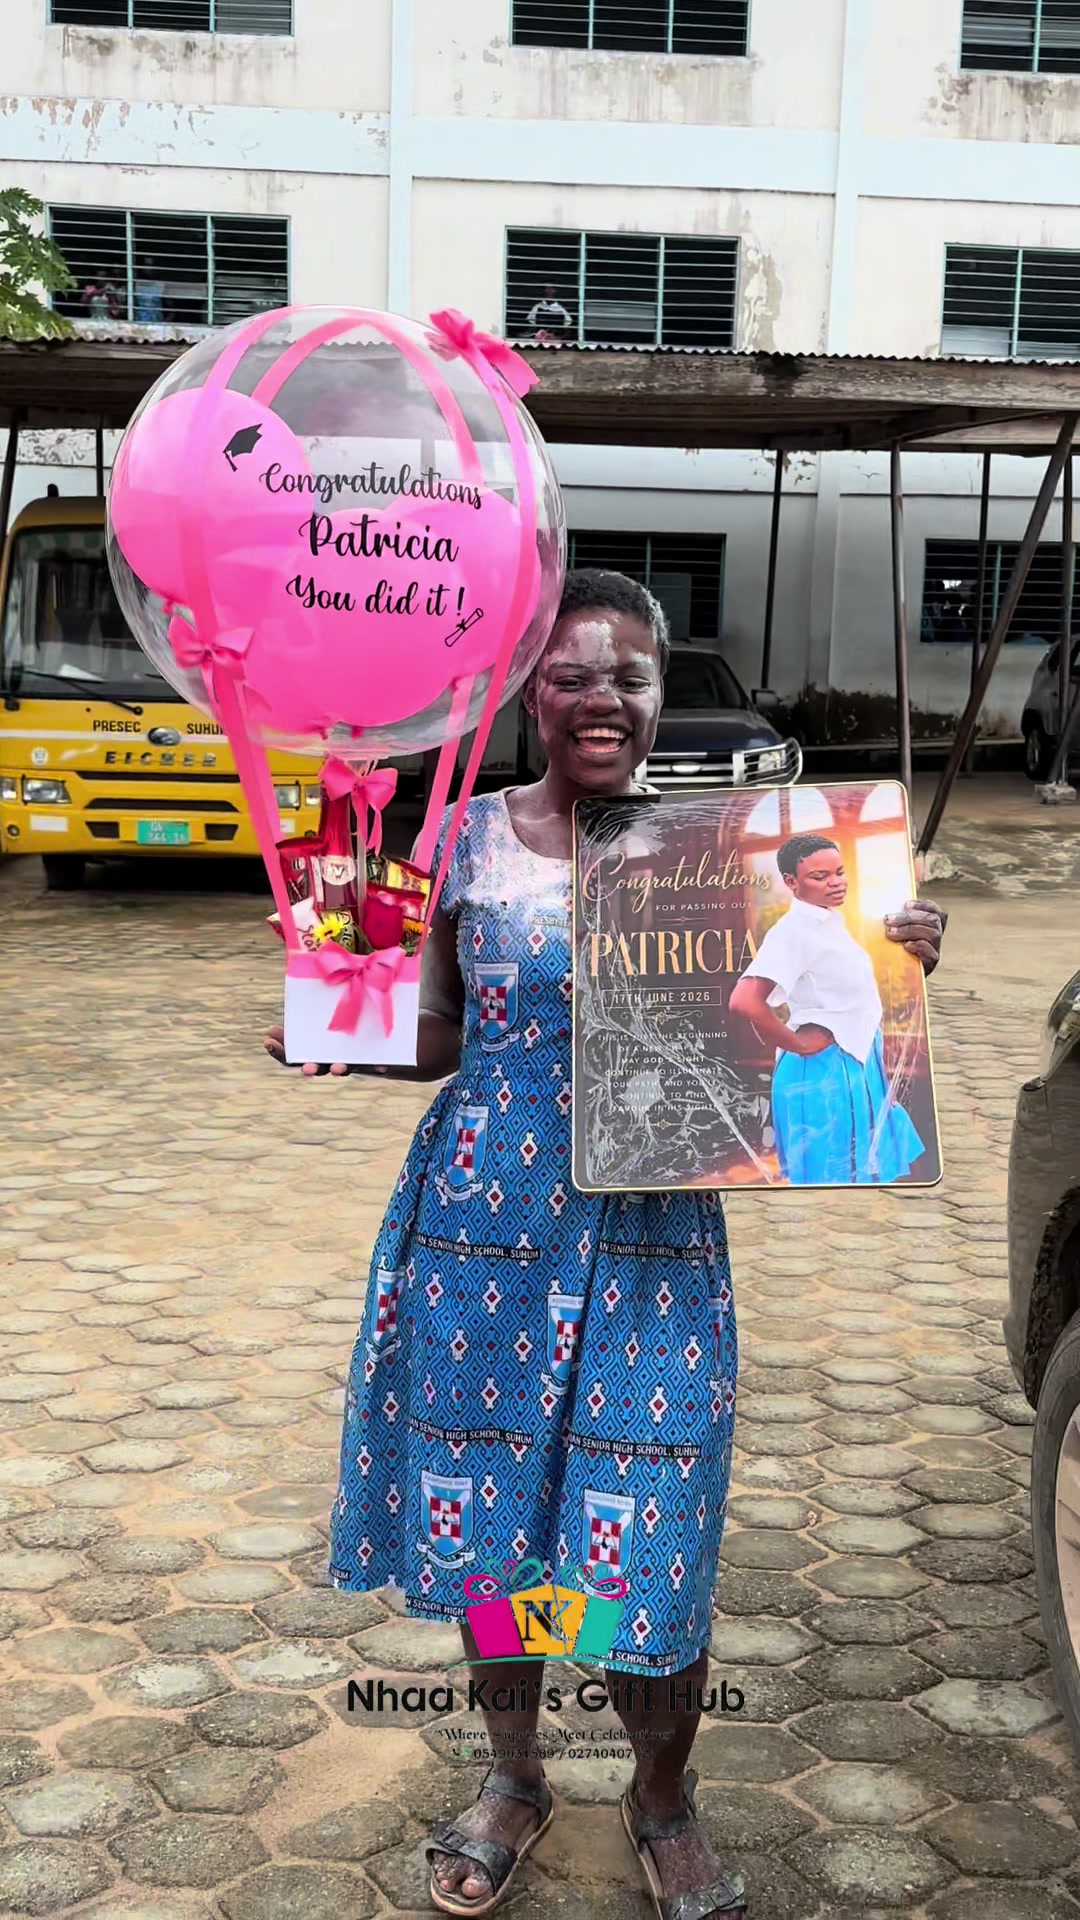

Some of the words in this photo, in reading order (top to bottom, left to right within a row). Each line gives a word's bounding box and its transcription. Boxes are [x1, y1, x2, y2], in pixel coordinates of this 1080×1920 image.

[259, 462, 483, 509] Congratulations
[299, 514, 459, 562] Patricia
[286, 574, 356, 611] You
[364, 579, 420, 615] did
[426, 583, 451, 616] it
[93, 720, 141, 733] PRESEC
[187, 723, 224, 735] SUHU
[583, 848, 772, 914] Congratulations
[680, 902, 726, 911] PASSING
[590, 928, 759, 978] PATRICIA
[614, 993, 642, 1004] 17TH
[648, 992, 674, 1003] JUNE
[681, 991, 710, 1002] 2026
[446, 1431, 467, 1440] HIGH
[506, 1433, 533, 1444] SUHUM
[582, 1437, 611, 1451] SENIOR
[612, 1442, 633, 1454] HIGH
[674, 1446, 700, 1457] SUHUM
[413, 1599, 441, 1613] SENIOR
[443, 1605, 464, 1616] HIGH
